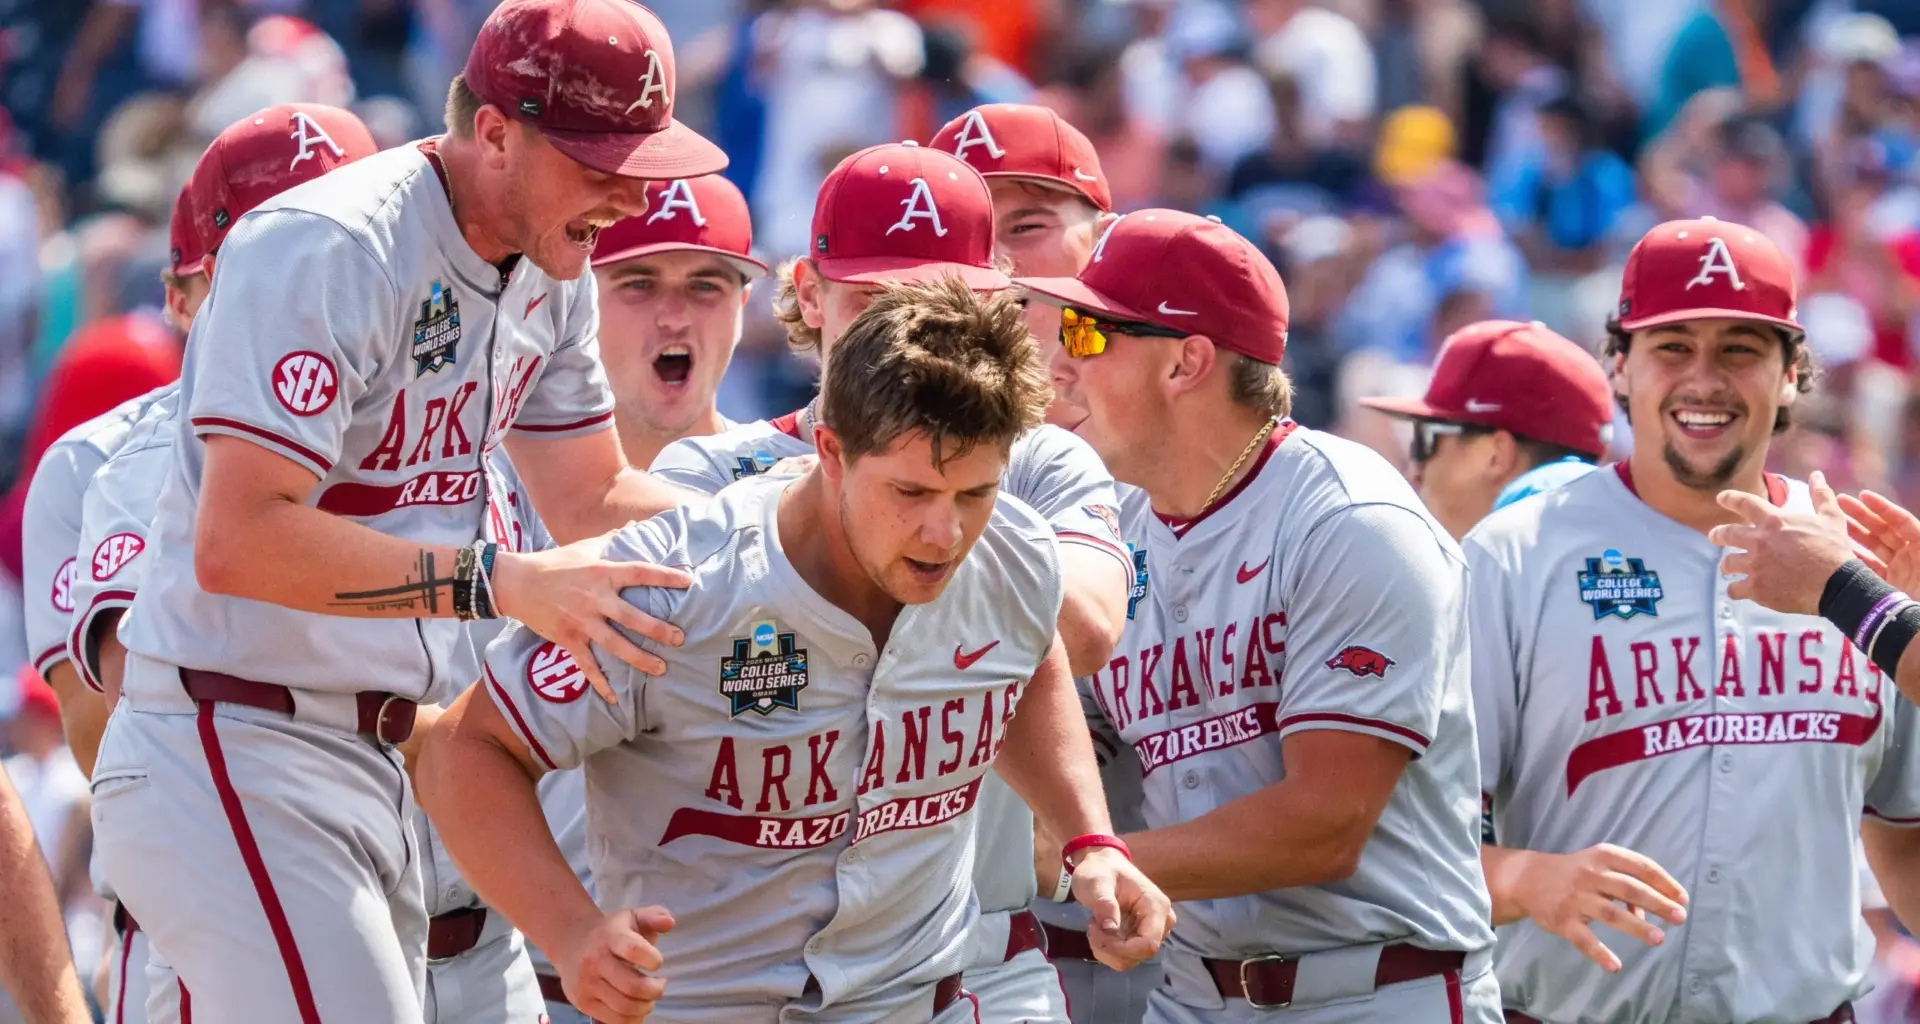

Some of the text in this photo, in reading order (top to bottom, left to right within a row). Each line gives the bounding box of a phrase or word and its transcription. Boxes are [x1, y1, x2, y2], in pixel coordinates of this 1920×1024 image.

[625, 50, 670, 114] A
[290, 112, 345, 171] A
[953, 110, 1006, 160] A
[646, 179, 707, 226] A
[886, 178, 949, 238] A
[1685, 237, 1746, 291] A
[414, 338, 440, 357] WORLD
[438, 327, 460, 347] SERIES
[425, 318, 451, 340] COLLEGE
[277, 354, 333, 412] SEC
[94, 535, 140, 579] SEC
[1582, 587, 1661, 600] WORLD SERIES
[1596, 578, 1642, 588] COLLEGE
[722, 673, 806, 692] WORLD SERIES
[740, 662, 788, 679] COLLEGE
[1585, 632, 1882, 721] ARKANSAS
[1135, 706, 1261, 773] RAZORBACKS
[1644, 713, 1841, 756] RAZORBACKS
